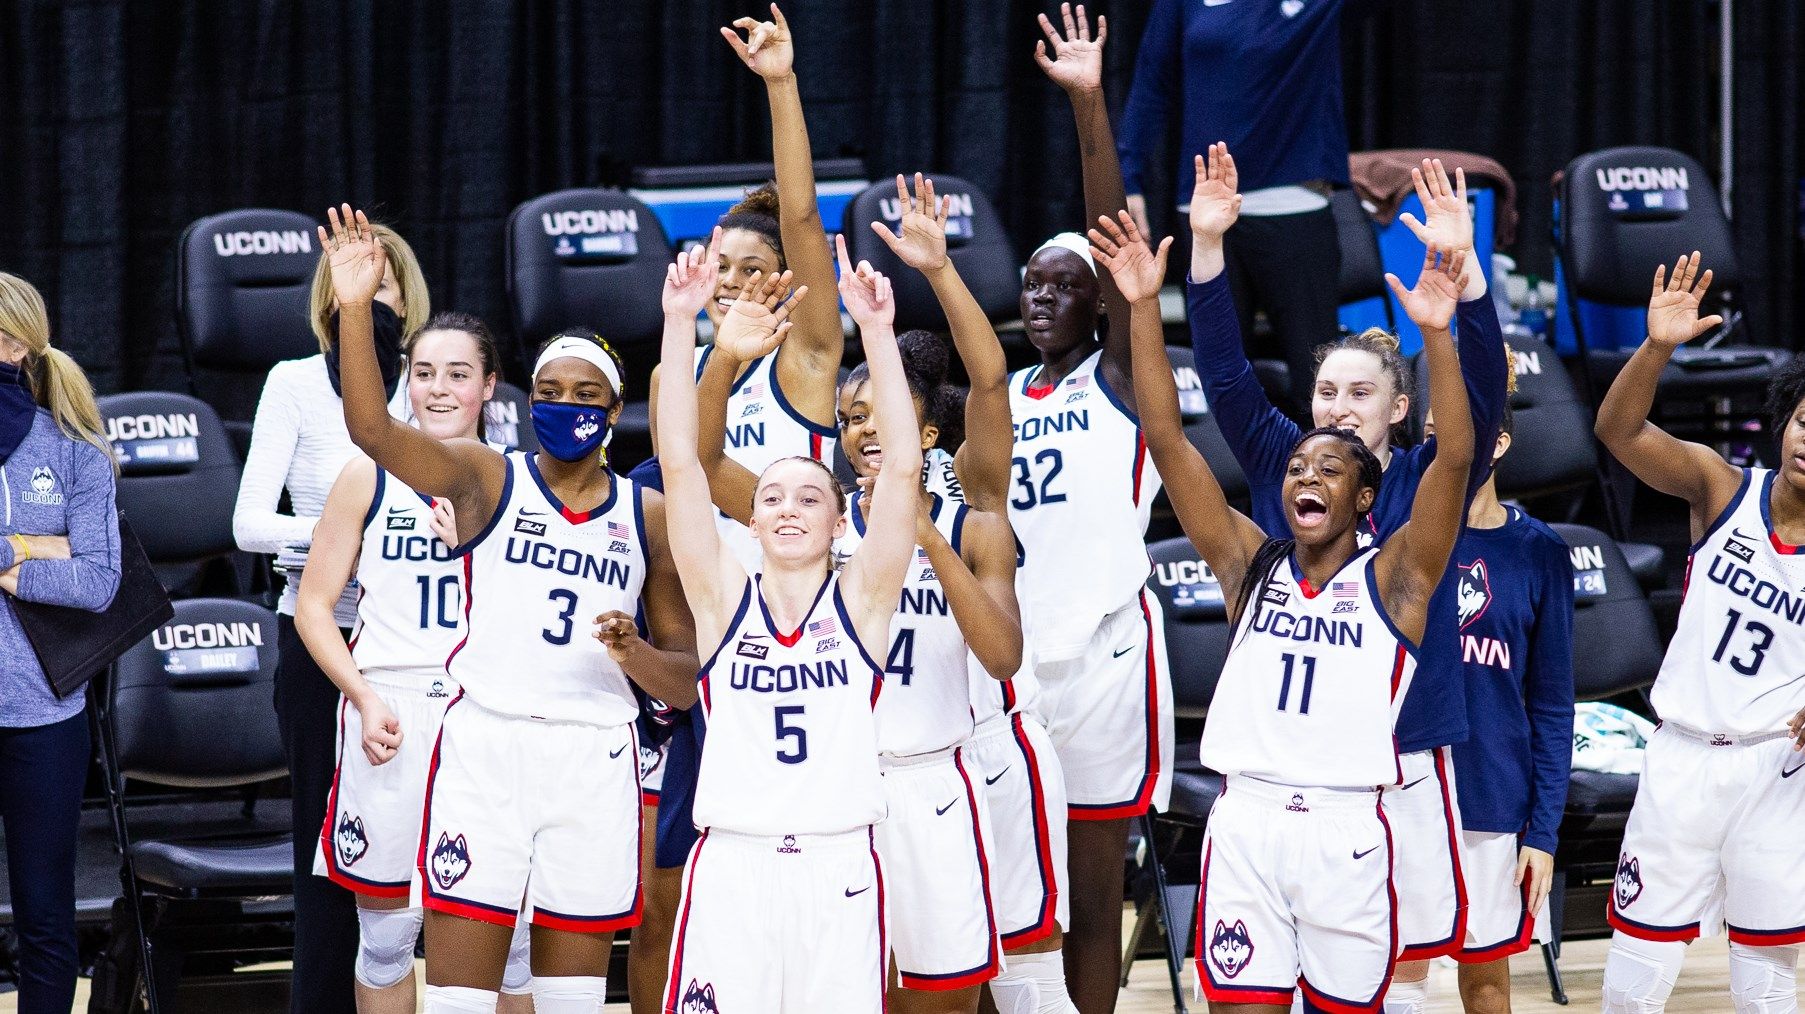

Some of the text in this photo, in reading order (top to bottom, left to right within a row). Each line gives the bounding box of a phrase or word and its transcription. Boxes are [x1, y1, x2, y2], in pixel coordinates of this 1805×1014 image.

[1596, 167, 1689, 191] UCONN
[542, 209, 639, 235] UCONN
[214, 231, 312, 256] UCONN
[1013, 410, 1088, 443] ONN
[1012, 449, 1066, 510] 32
[22, 491, 64, 504] UCONN
[388, 517, 415, 528] BLM
[517, 520, 544, 533] BLM
[505, 537, 630, 590] UCONN
[609, 545, 631, 554] EAST
[1729, 542, 1753, 558] BLM
[417, 575, 460, 629] 10
[896, 587, 948, 616] NN
[1265, 589, 1288, 603] BLM
[1707, 554, 1805, 625] UCON
[542, 588, 578, 645] 3
[1253, 609, 1362, 648] UCONN
[152, 622, 262, 650] UCONN
[738, 643, 767, 657] BLM
[816, 641, 841, 652] EAST
[817, 637, 835, 647] BIG
[1712, 608, 1775, 676] 13
[884, 628, 915, 685] 4
[1460, 635, 1510, 669] NN
[730, 659, 848, 693] UCONN
[1277, 652, 1316, 715] 11
[774, 705, 807, 764] 5
[1286, 804, 1309, 812] UCONN
